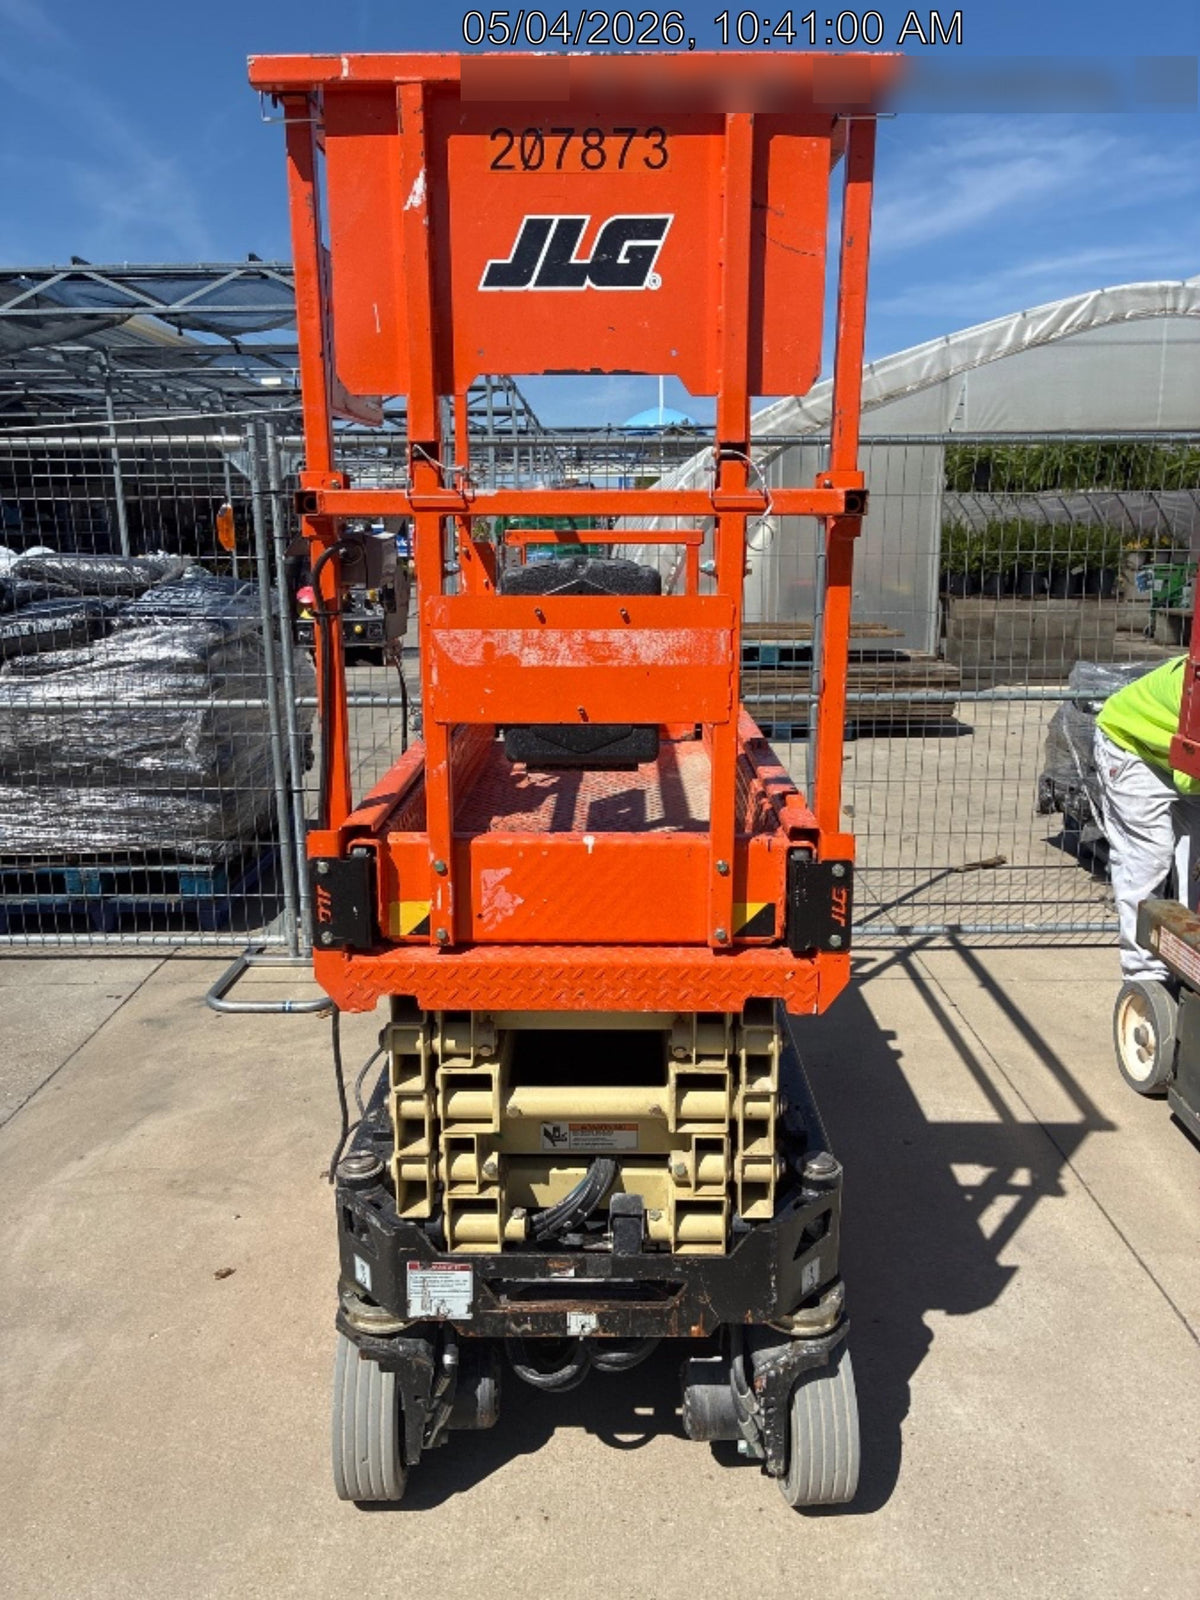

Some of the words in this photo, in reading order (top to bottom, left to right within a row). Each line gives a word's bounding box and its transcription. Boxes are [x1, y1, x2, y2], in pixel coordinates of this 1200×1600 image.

[490, 127, 669, 170] 207873
[316, 884, 331, 922] JLG
[832, 887, 847, 927] JLG
